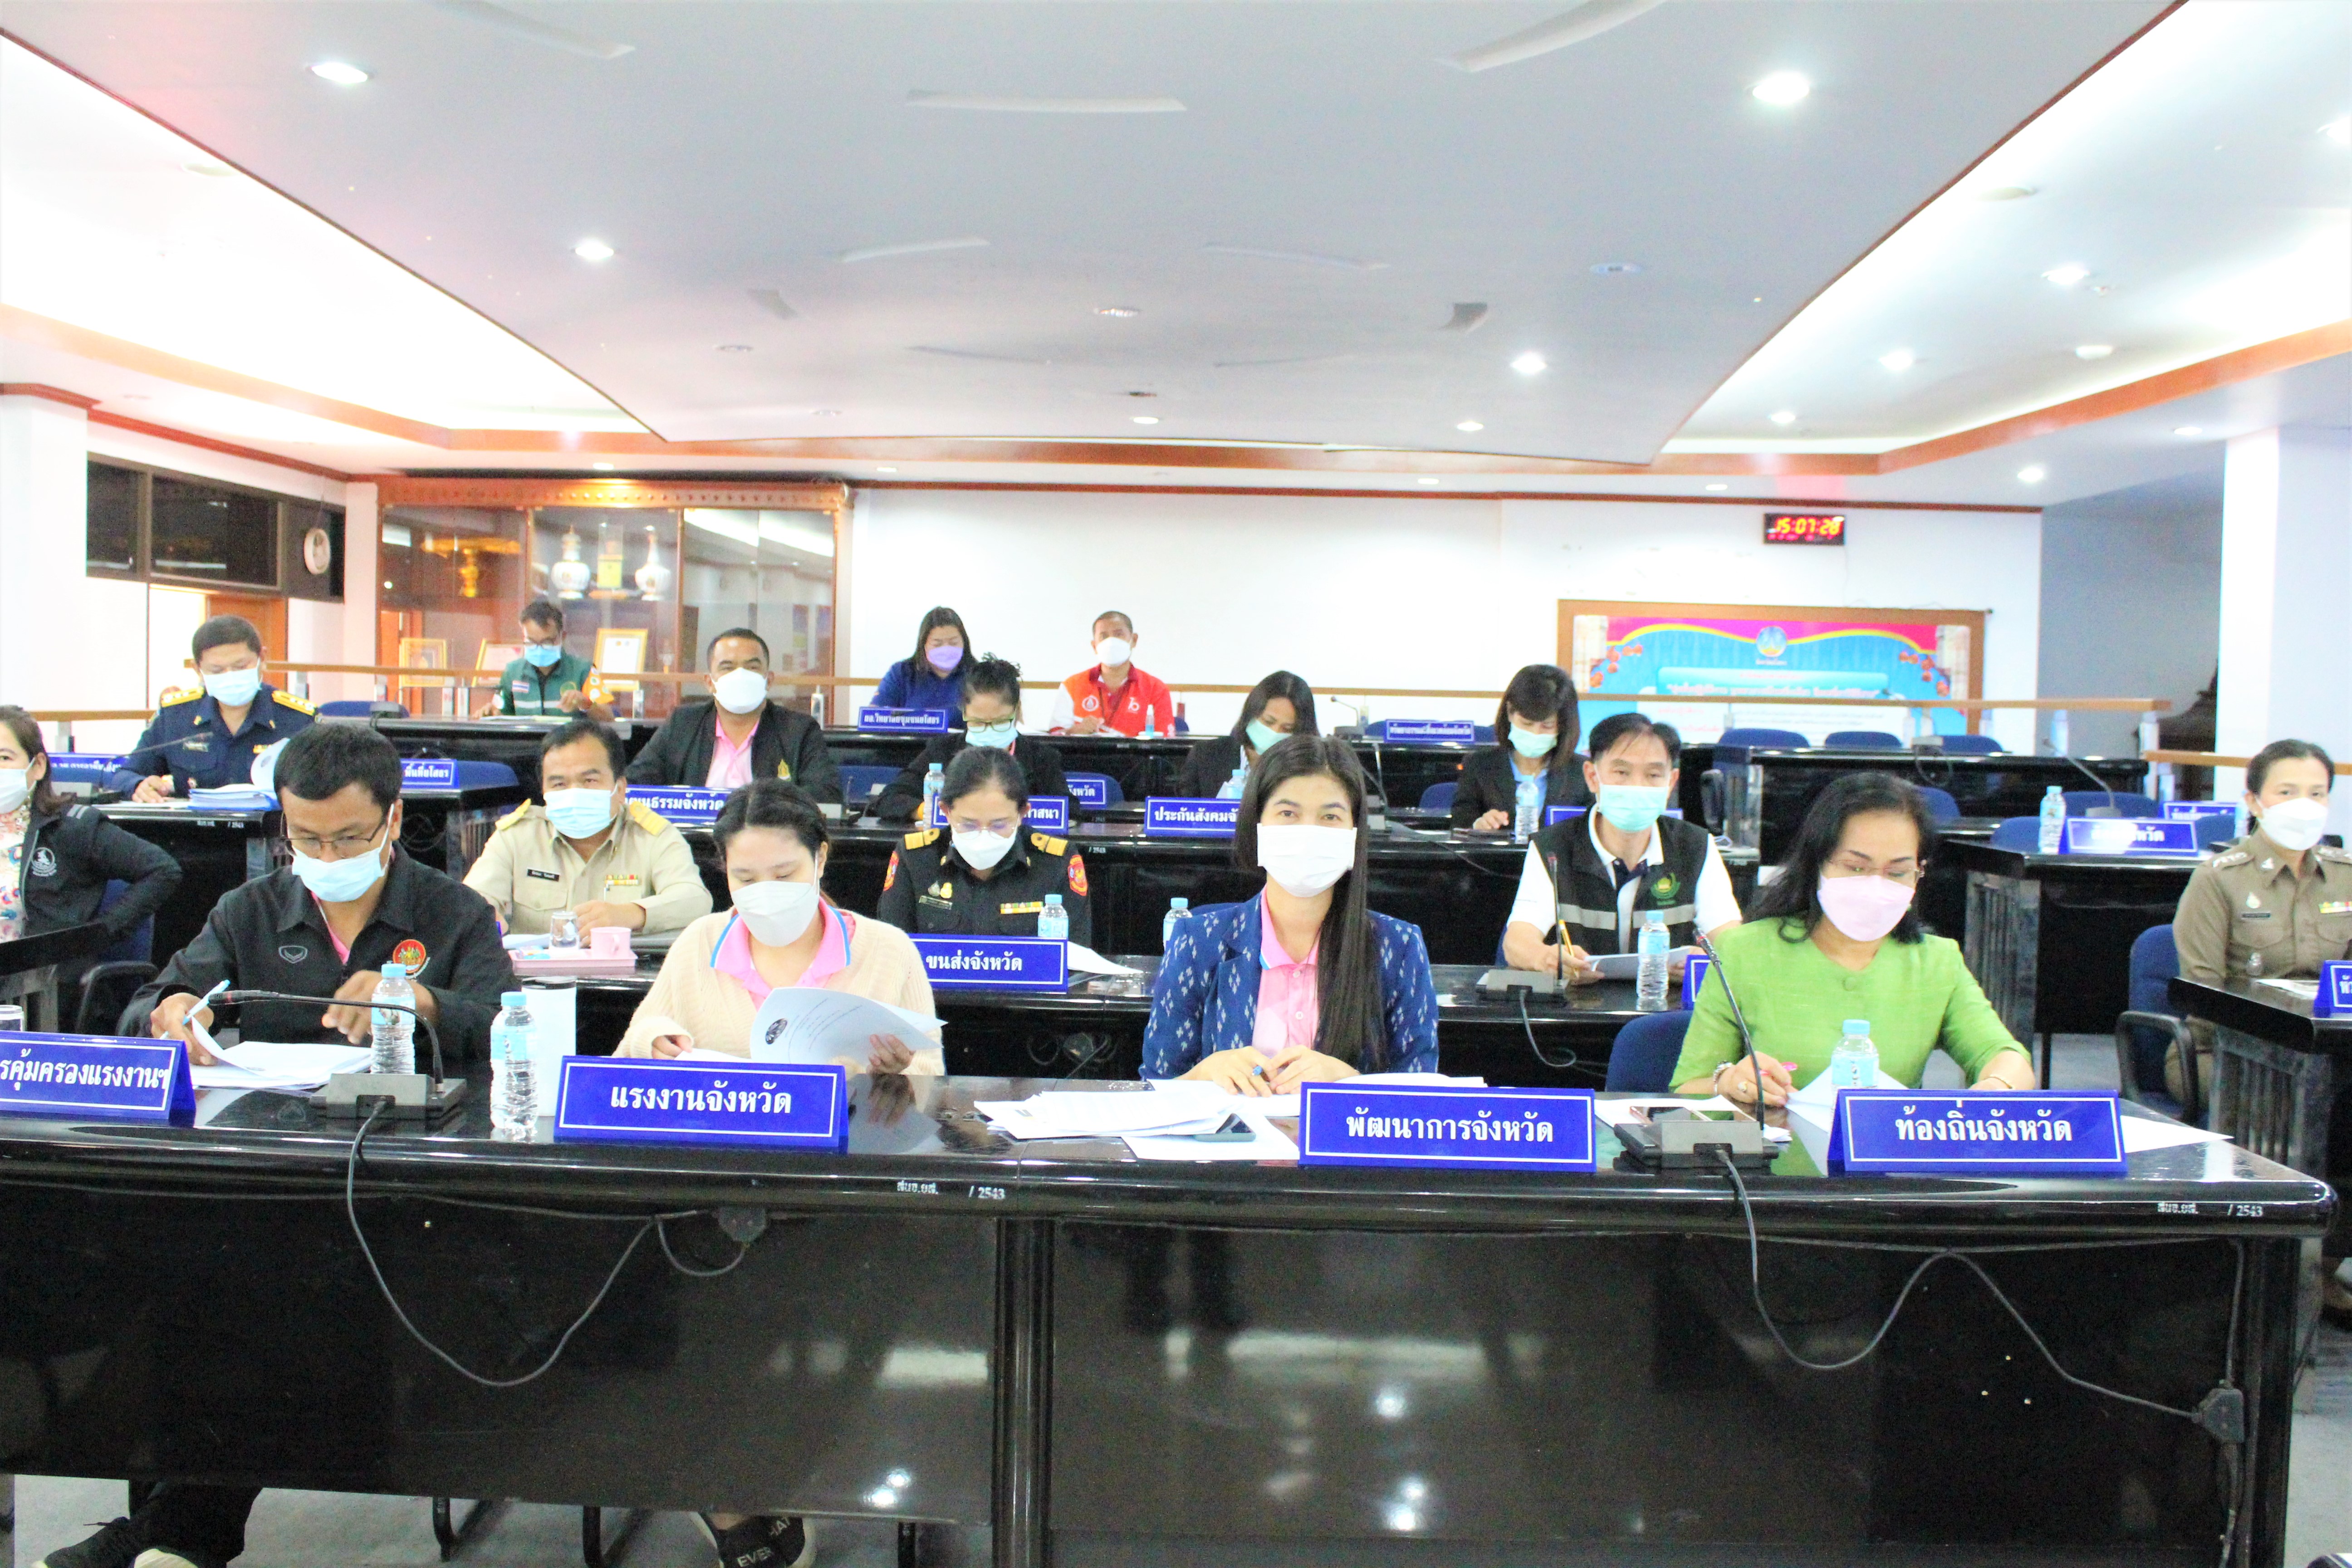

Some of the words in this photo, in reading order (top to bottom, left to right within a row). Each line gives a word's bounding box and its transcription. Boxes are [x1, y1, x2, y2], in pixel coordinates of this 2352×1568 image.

[926, 949, 1023, 971] ขนส่งจังหวัด
[610, 1080, 792, 1113] แรงงานจังหวัด
[1346, 1106, 1553, 1143] พัฒนาการจังหวัด
[1895, 1100, 2073, 1142] ท้องถิ่นจังหวัด
[978, 1186, 1006, 1200] 2543
[2236, 1205, 2264, 1217] 2543
